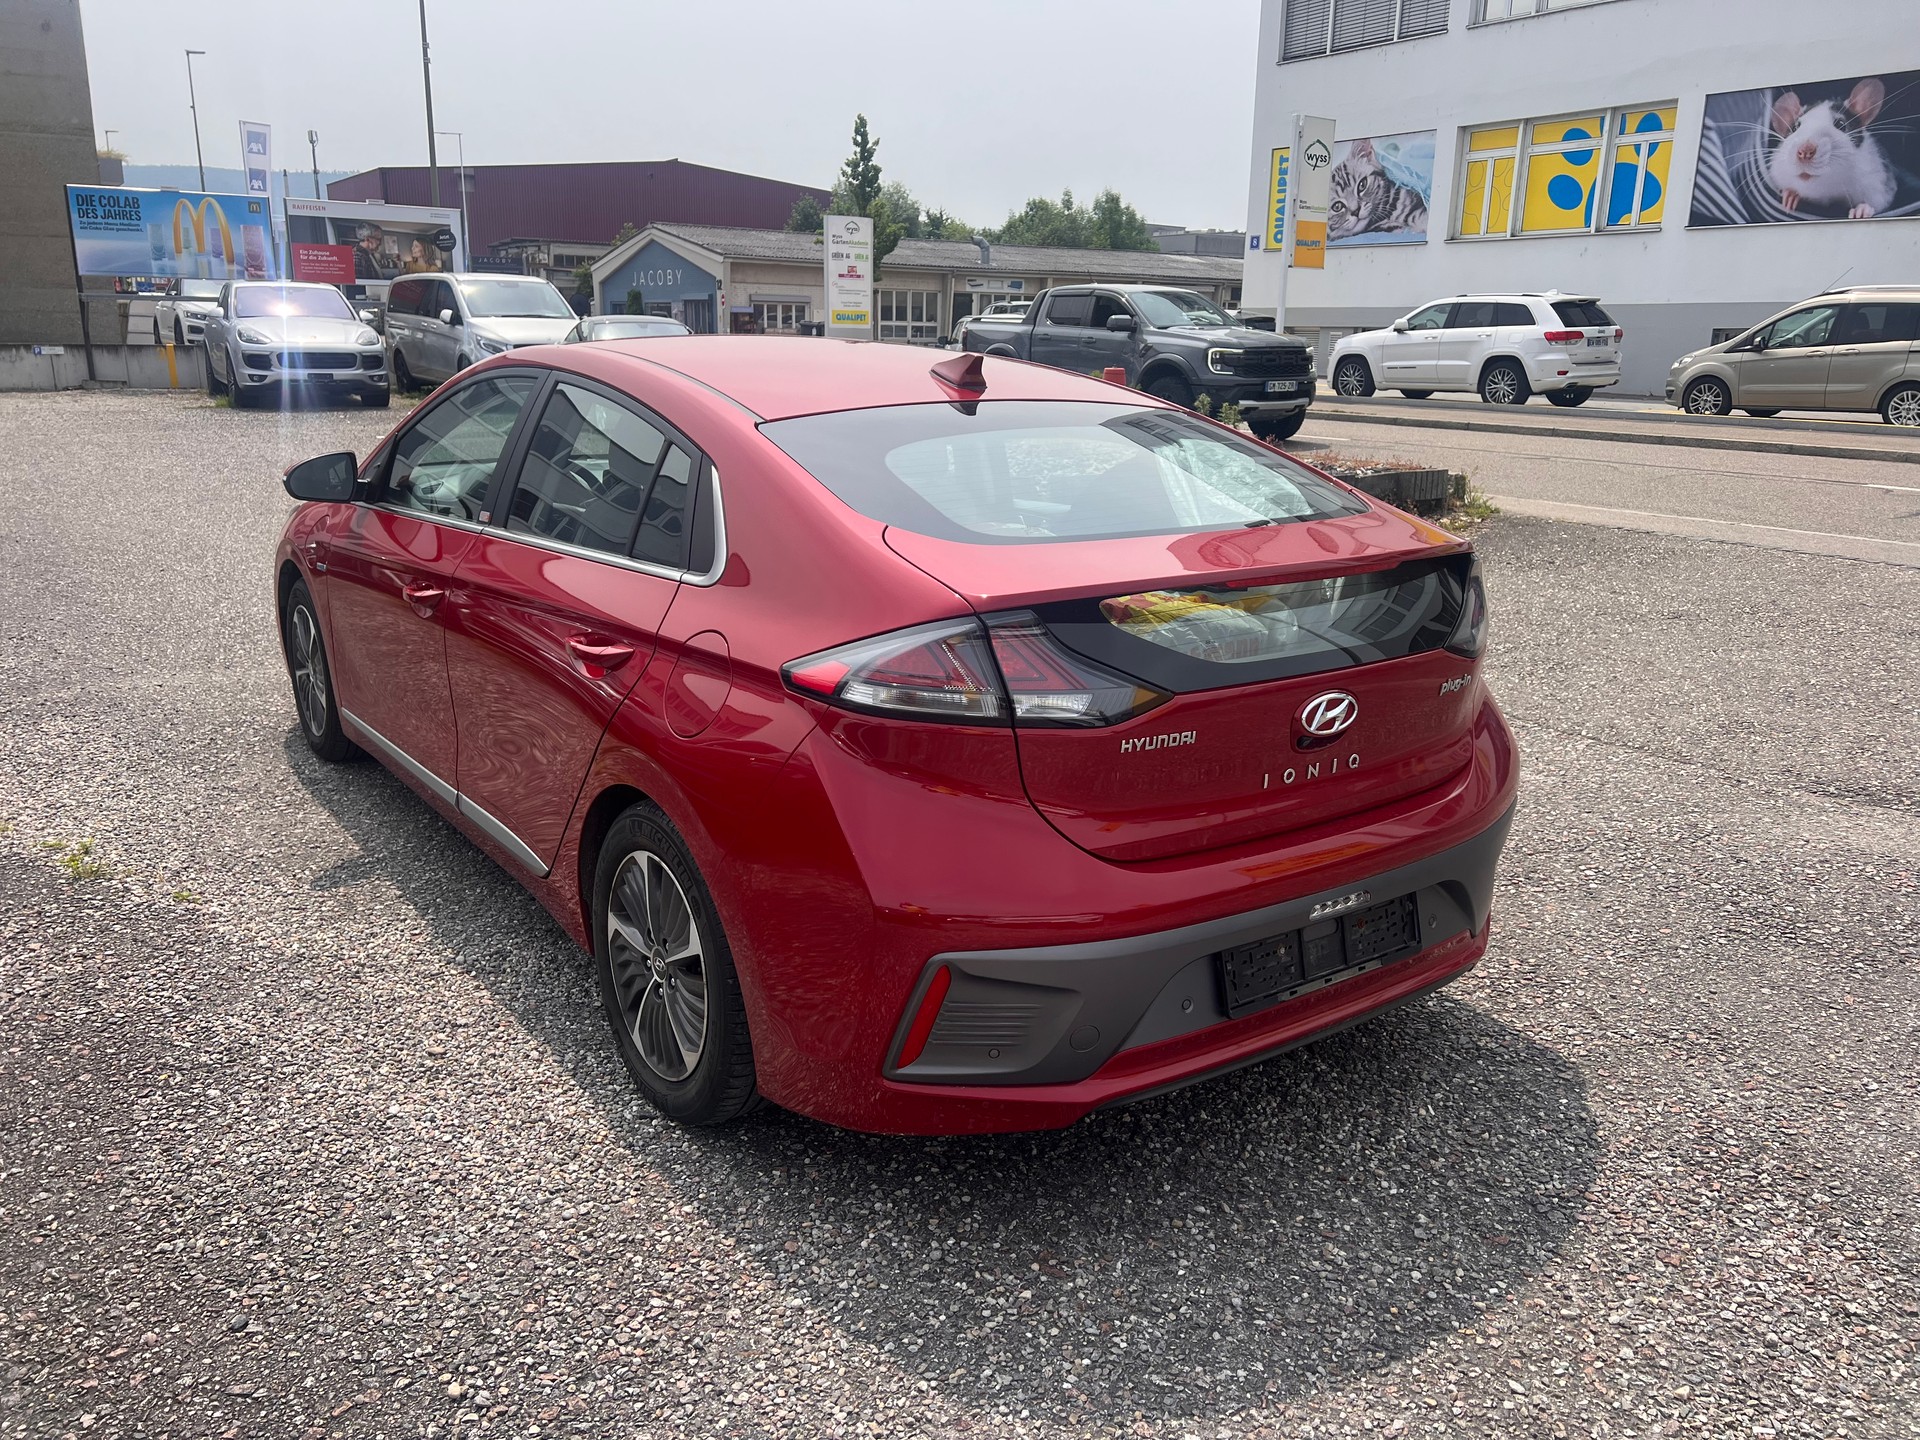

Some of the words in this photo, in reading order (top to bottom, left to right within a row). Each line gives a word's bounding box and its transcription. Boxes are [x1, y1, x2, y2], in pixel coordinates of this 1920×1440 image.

[1306, 153, 1328, 171] wyss
[76, 194, 96, 207] DIE
[99, 195, 140, 209] COLAB
[1273, 154, 1290, 244] QUALIPET
[78, 208, 98, 219] DES
[101, 209, 141, 221] JAHRES
[1252, 238, 1257, 246] 8
[632, 269, 683, 286] JACOBY
[1439, 673, 1472, 697] plug-in
[1120, 731, 1197, 754] HYUNDAI
[1263, 753, 1361, 790] IONIQ
